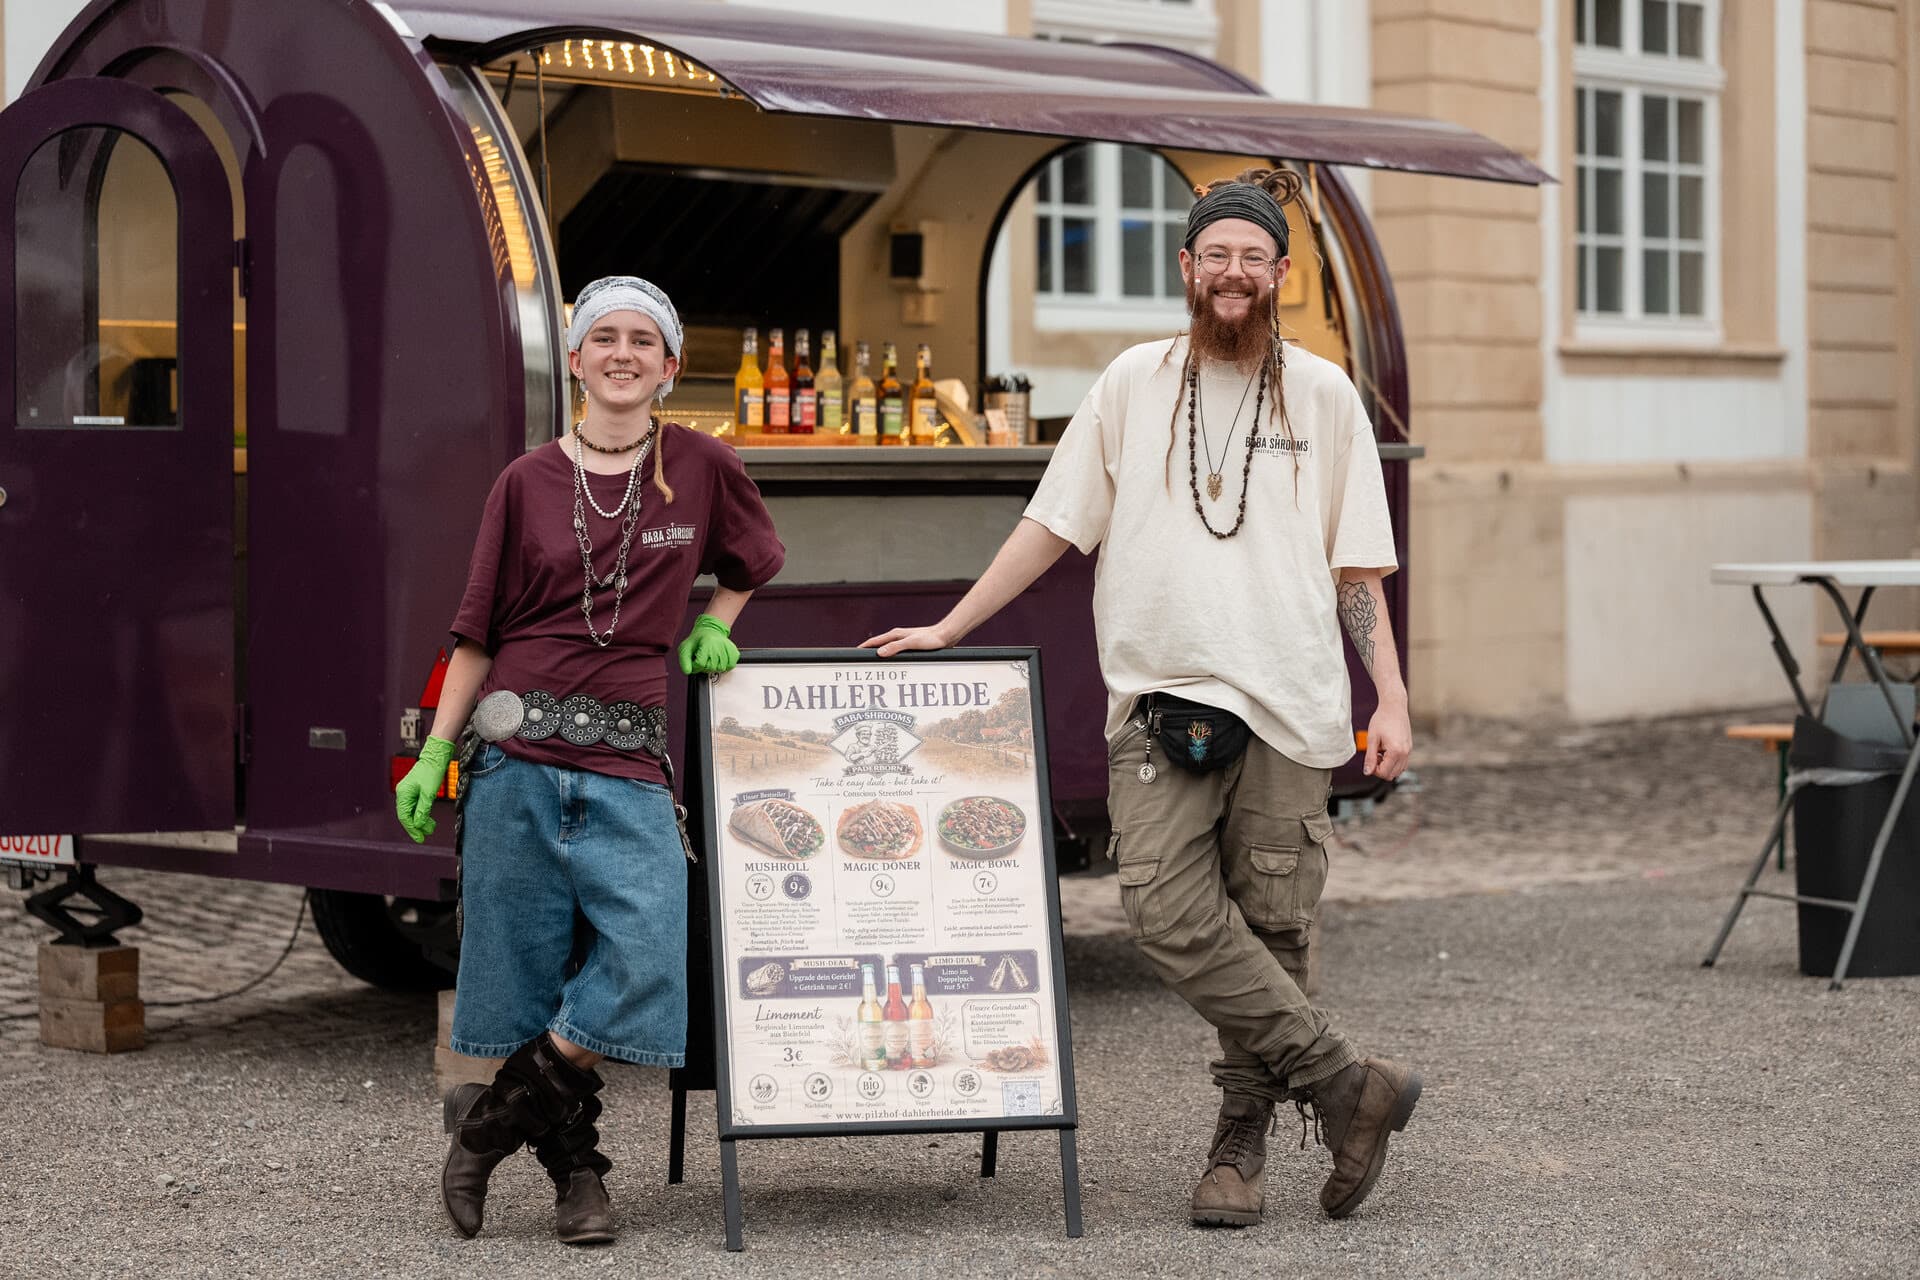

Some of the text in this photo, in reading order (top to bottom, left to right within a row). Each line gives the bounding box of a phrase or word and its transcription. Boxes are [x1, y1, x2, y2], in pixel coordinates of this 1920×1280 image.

[1245, 436, 1266, 448] BBA
[641, 530, 665, 545] BABA
[835, 671, 908, 681] PILZHOF
[762, 682, 991, 710] DAHLER HEIDE
[851, 764, 905, 773] PADERBORN
[843, 789, 913, 798] Conscious Streetfood
[744, 862, 809, 872] MUSHROLL
[843, 862, 879, 872] MAGIC
[950, 859, 1020, 870] MAGIC BOWL
[754, 882, 768, 894] 7€
[790, 882, 805, 894] 9€
[876, 879, 890, 892] 9€
[979, 878, 992, 888] 7€
[788, 972, 856, 983] Upgrade dein Gericht!
[938, 976, 974, 984] Doppelpack
[755, 1004, 824, 1022] Limoment
[755, 1022, 824, 1032] Regionale Limonaden
[783, 1046, 804, 1062] 3€
[863, 1080, 880, 1091] BIO
[835, 1108, 968, 1120] www.pilzhof-dahlerheide.de
